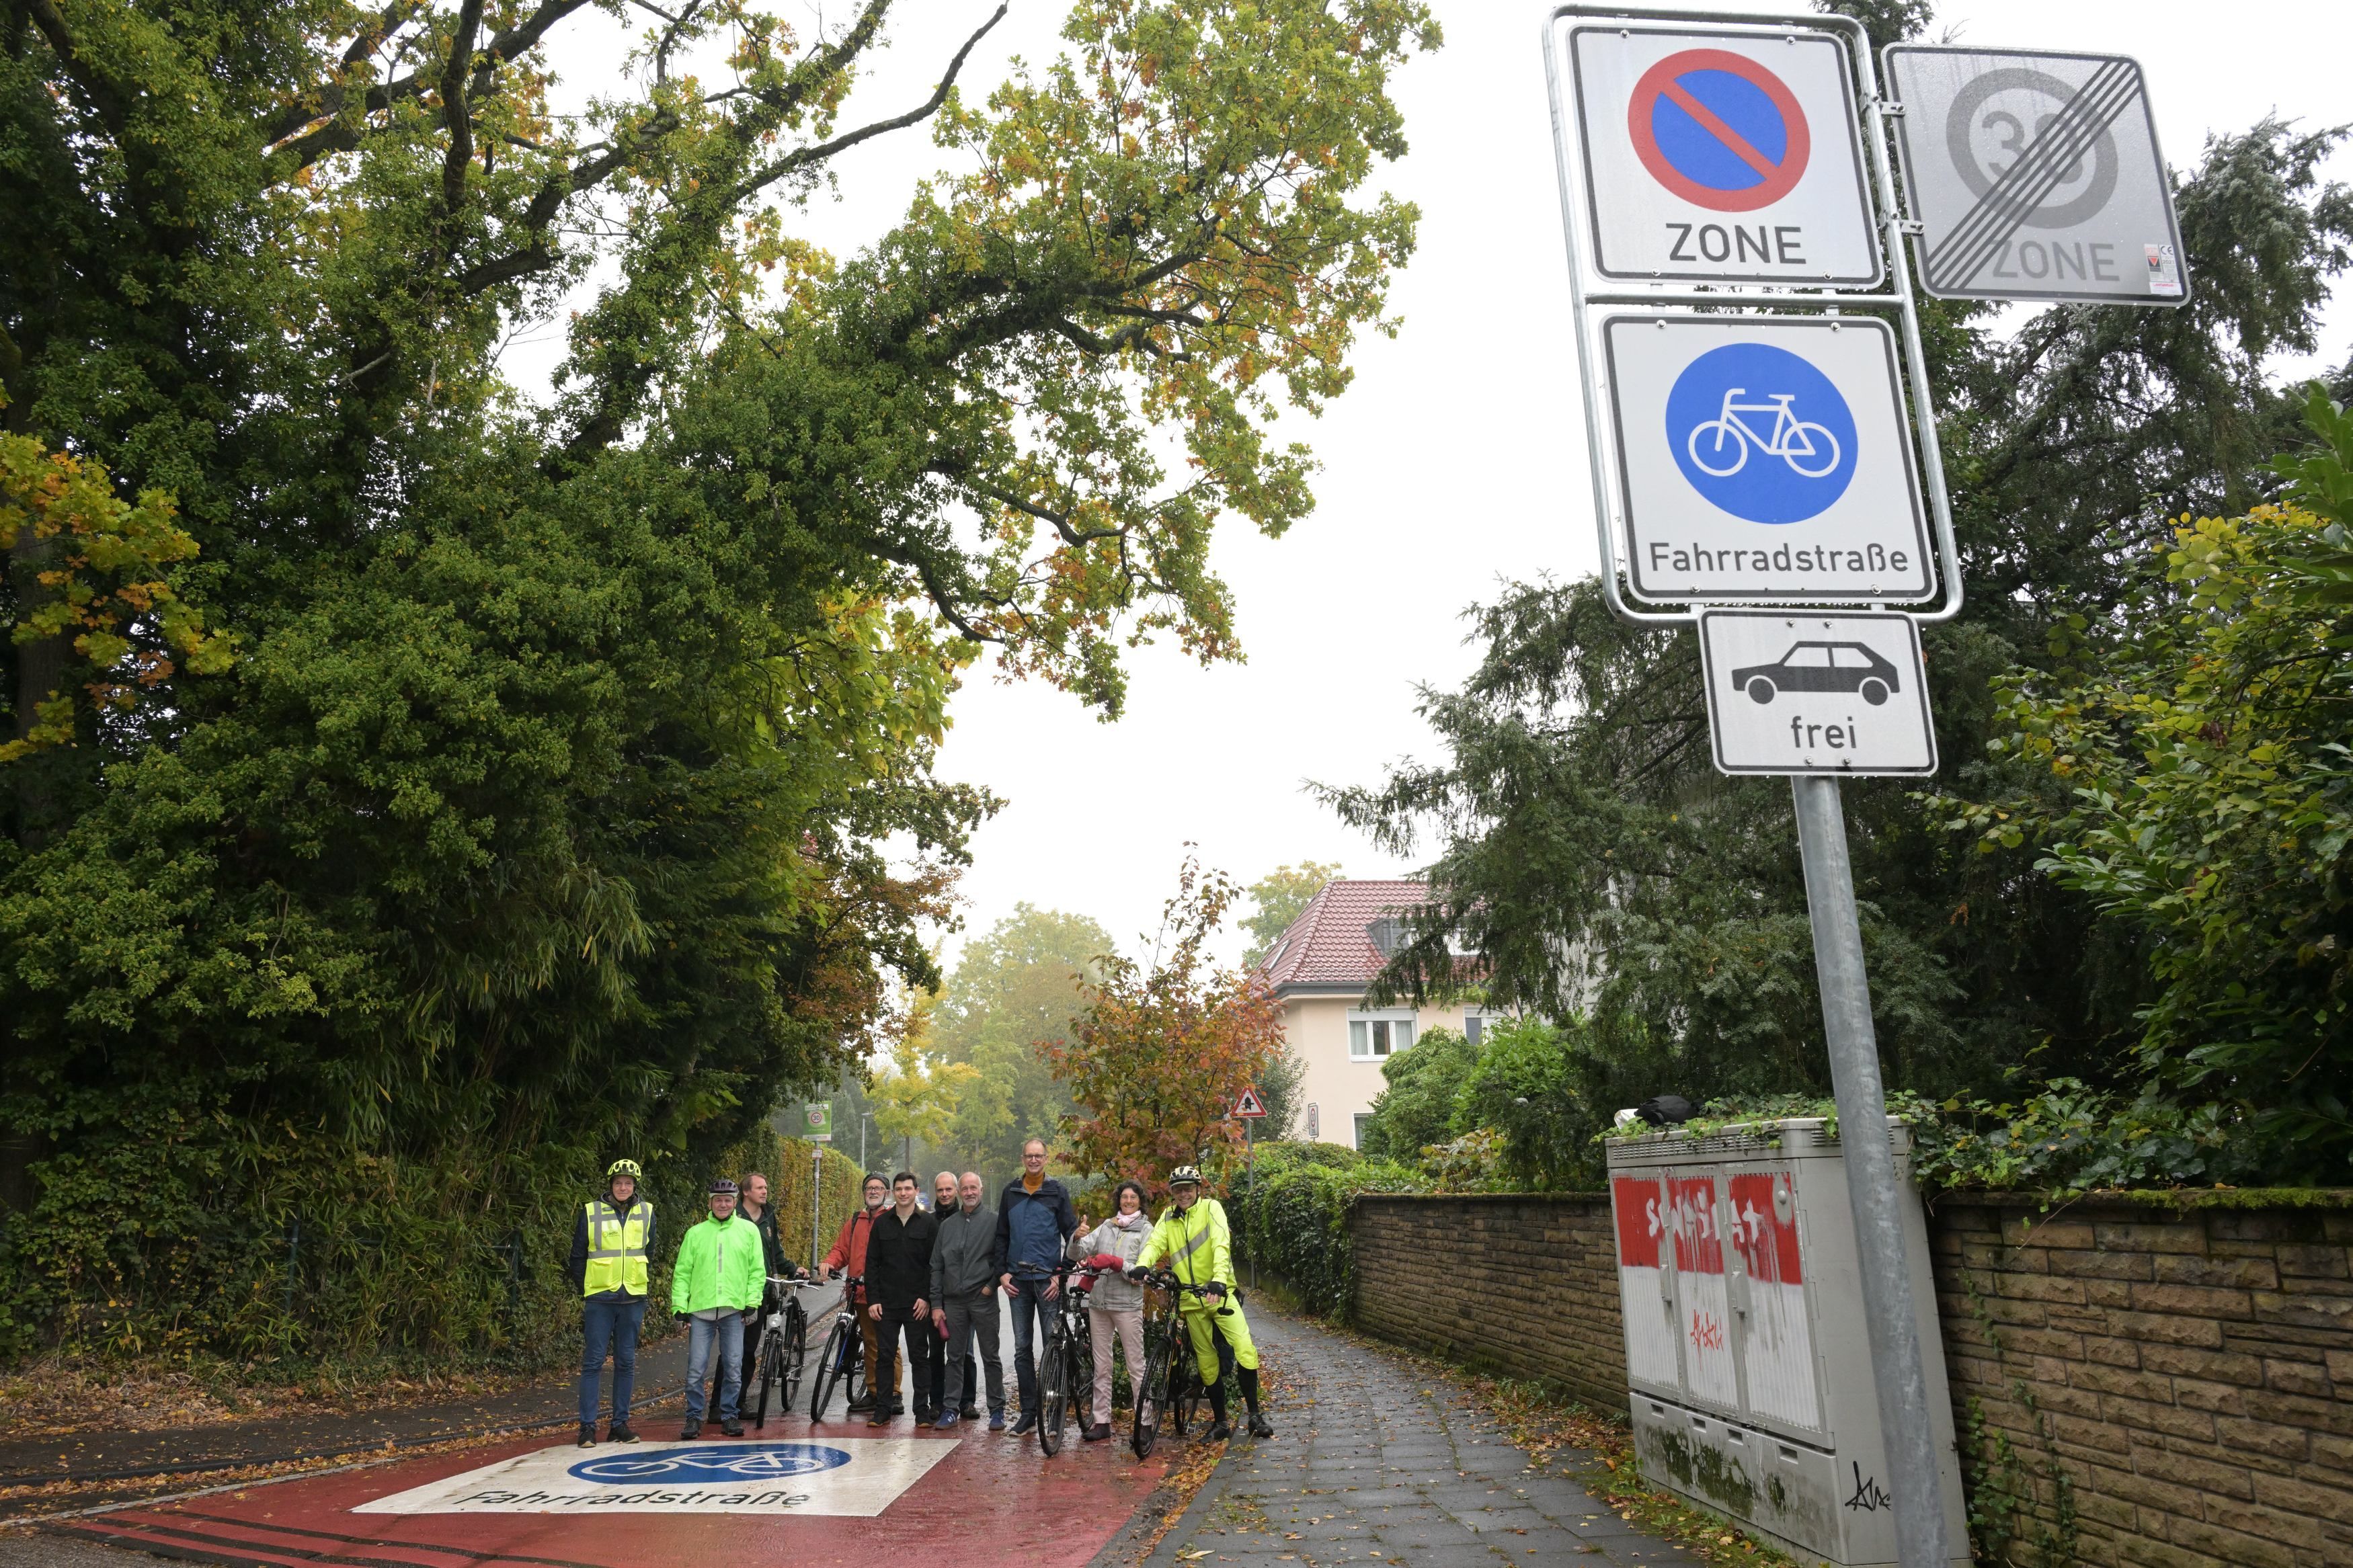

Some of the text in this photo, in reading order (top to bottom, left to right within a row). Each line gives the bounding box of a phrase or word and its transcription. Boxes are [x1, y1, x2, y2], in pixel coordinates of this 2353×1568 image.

[1981, 110, 2083, 184] 30
[1665, 222, 1806, 264] ZONE
[1989, 239, 2120, 282] ZONE
[1649, 542, 1909, 572] Fahrradstraße
[1791, 716, 1857, 749] frei
[452, 1490, 811, 1505] Fahrradstraße
